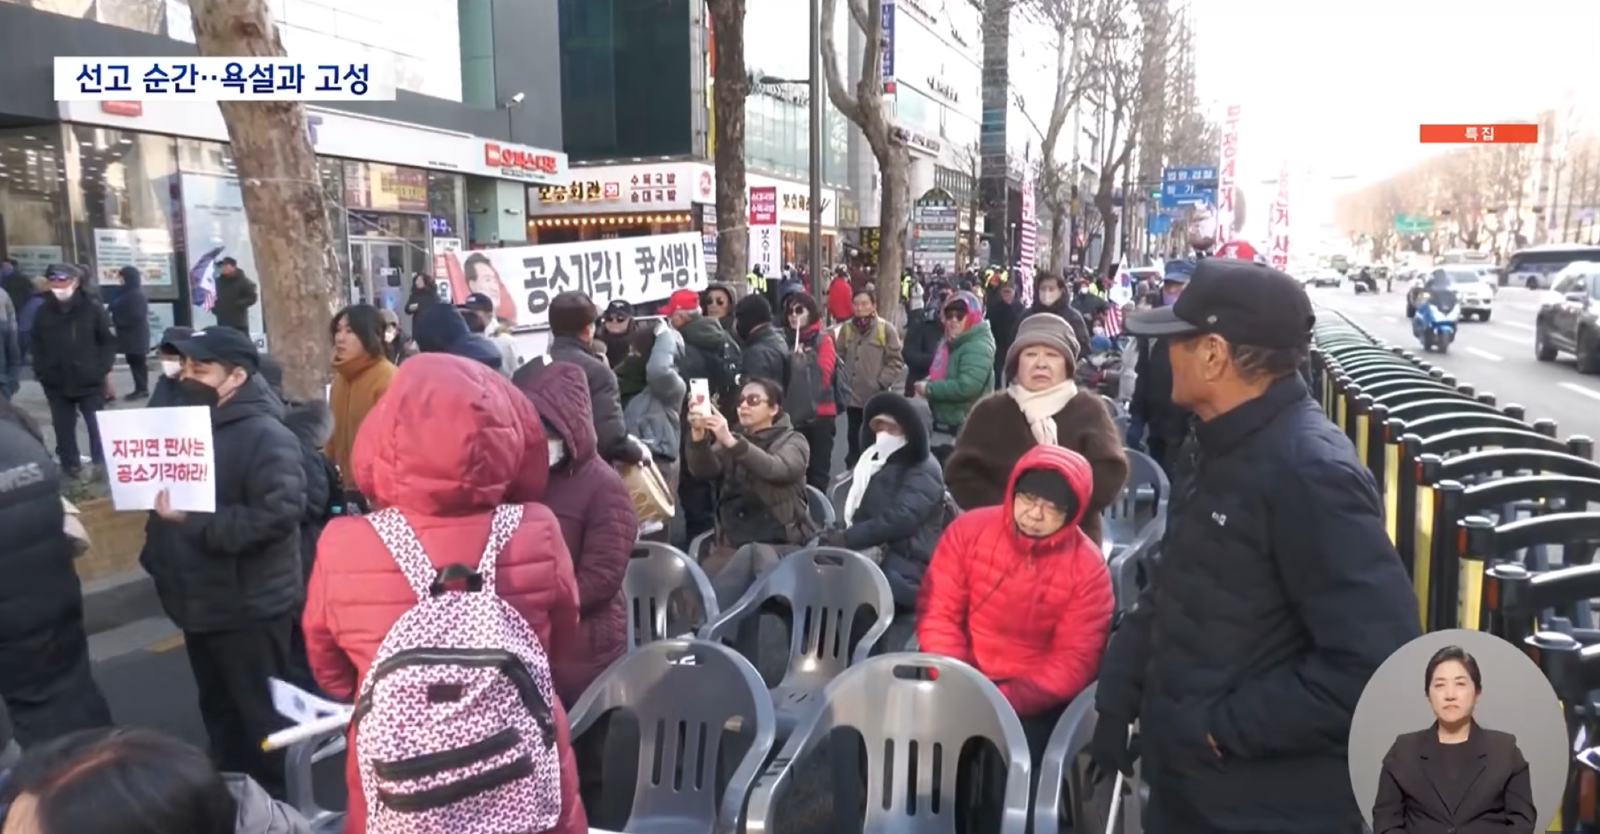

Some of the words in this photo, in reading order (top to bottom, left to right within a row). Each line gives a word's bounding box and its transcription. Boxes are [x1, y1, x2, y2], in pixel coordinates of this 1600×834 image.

[522, 250, 625, 314] 공소기각!
[112, 438, 160, 458] 지귀연
[164, 437, 206, 457] 판사는
[117, 462, 208, 484] 공소기각하라!
